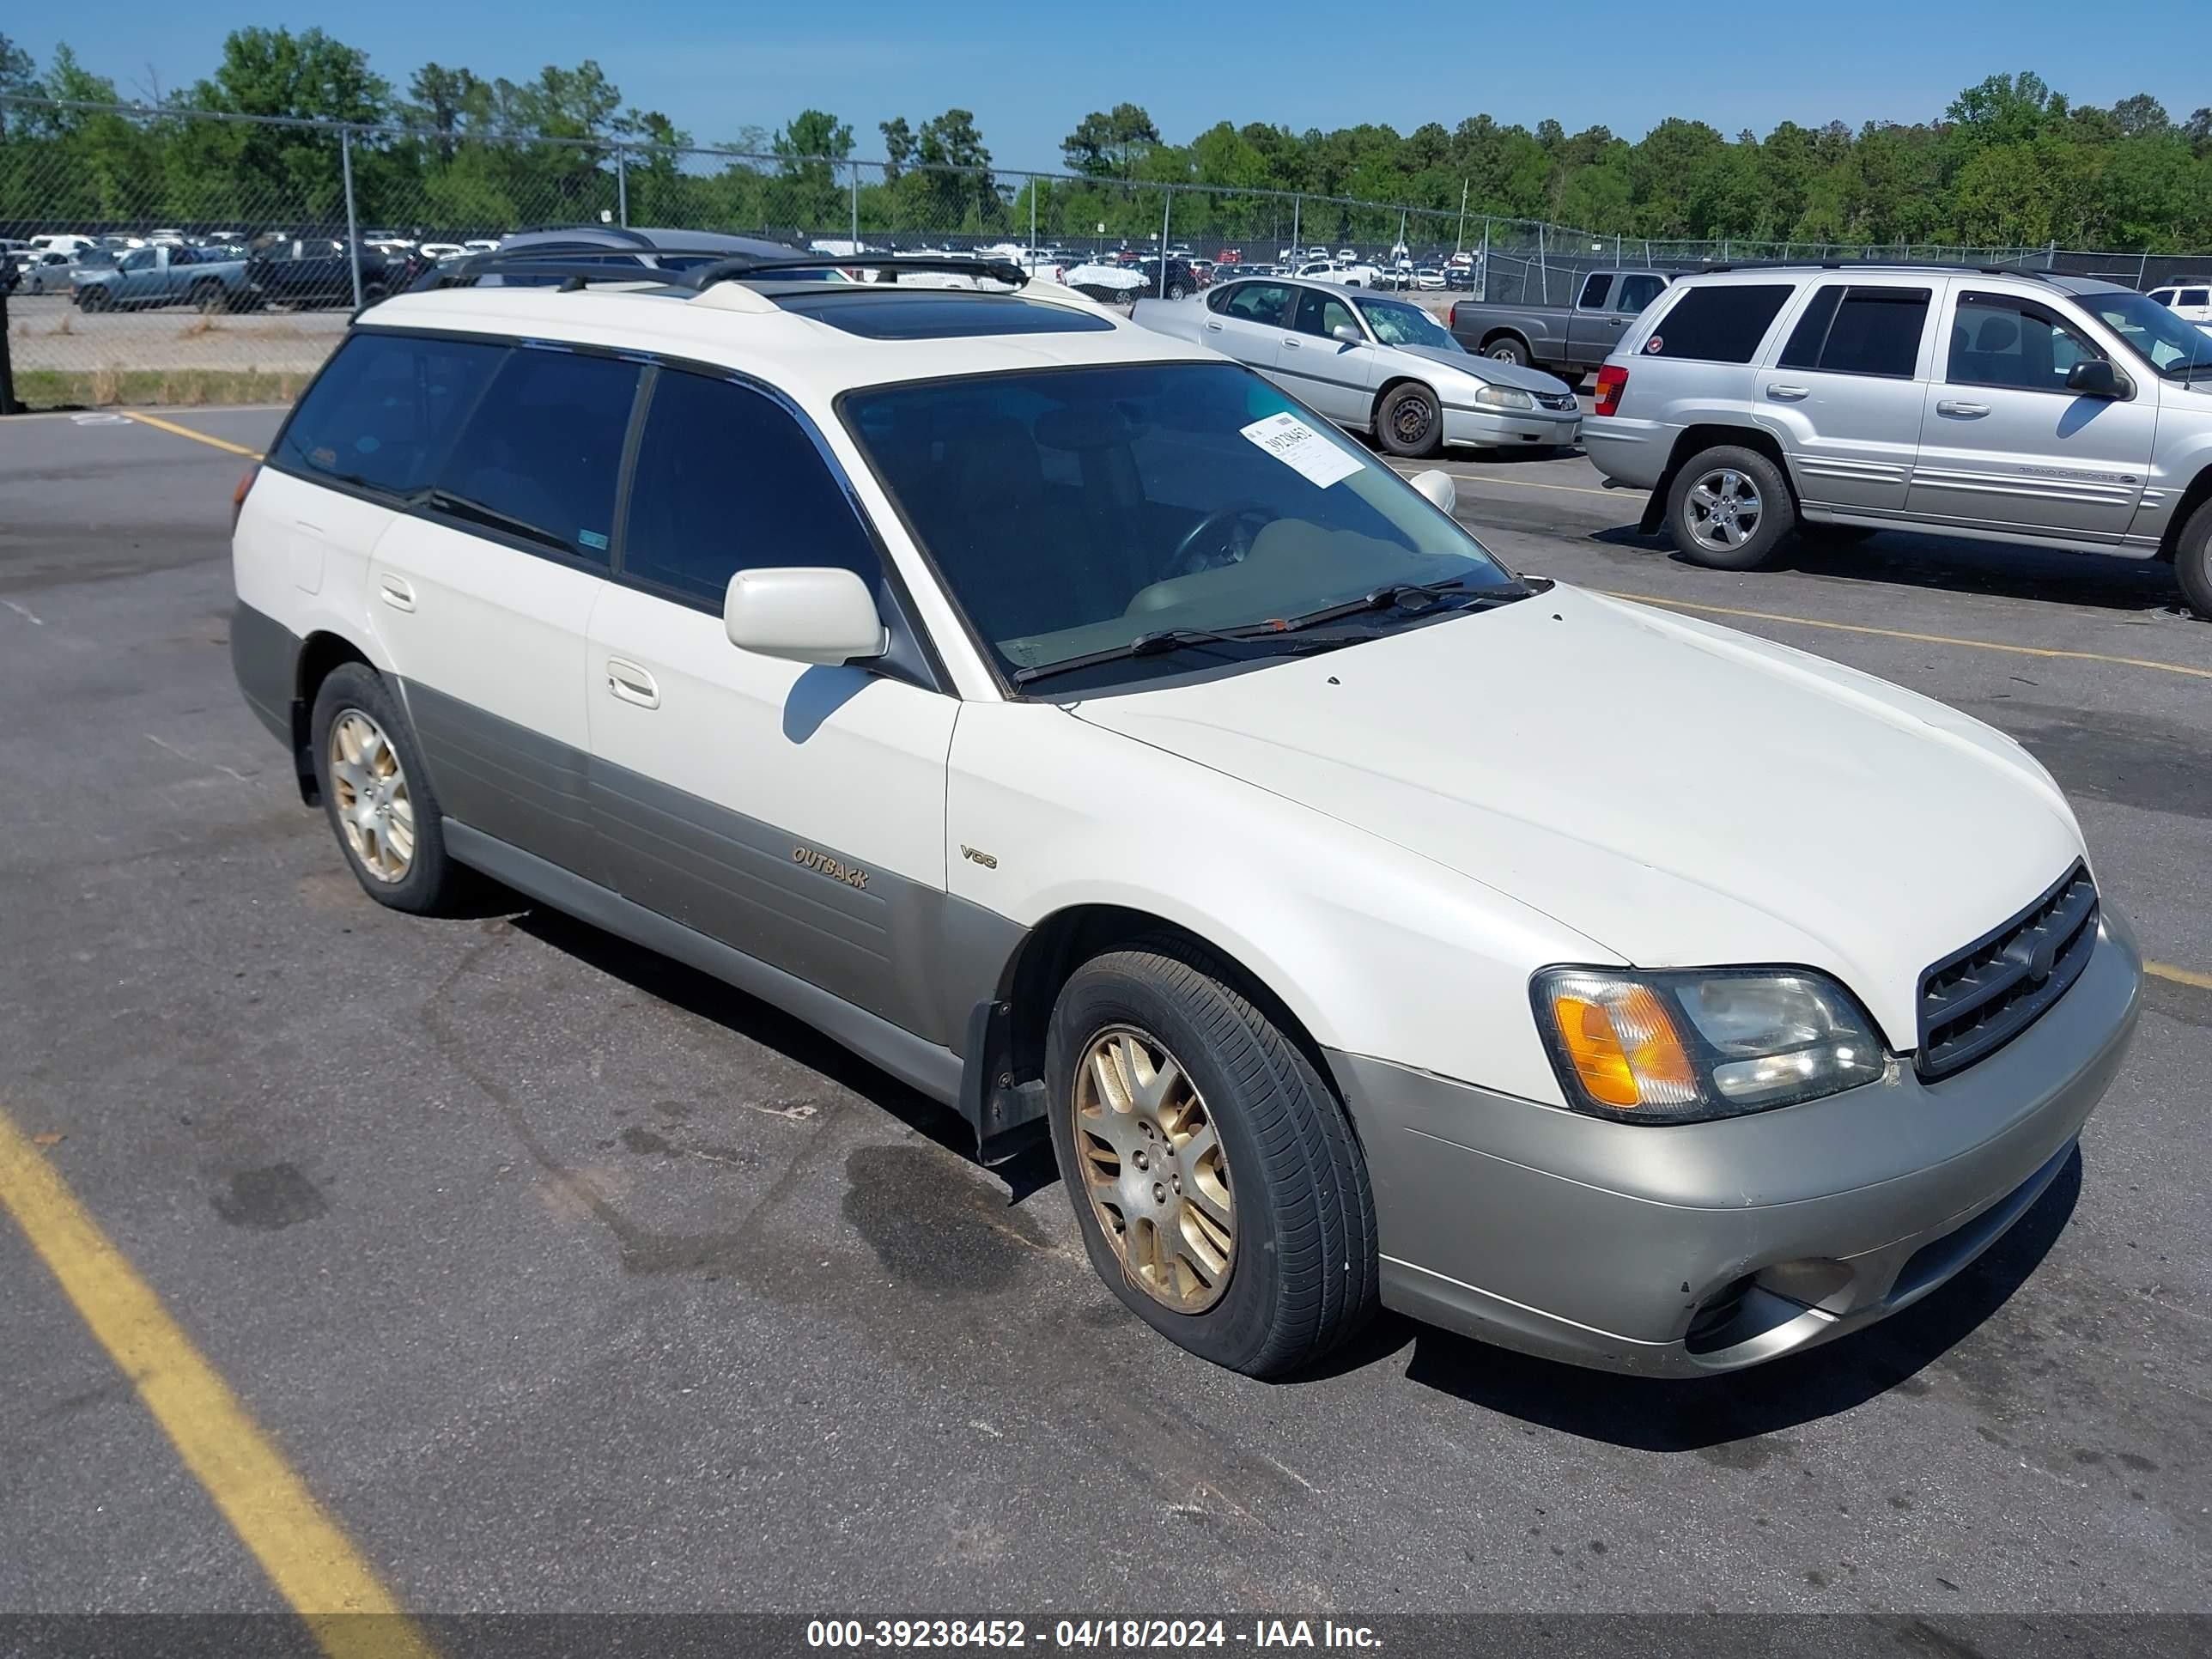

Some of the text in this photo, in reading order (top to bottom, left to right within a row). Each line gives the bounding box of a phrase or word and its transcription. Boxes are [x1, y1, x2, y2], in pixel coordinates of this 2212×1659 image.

[1265, 427, 1313, 453] 39238452
[2019, 466, 2056, 475] GRAND
[2058, 471, 2117, 481] CHEROKEE
[792, 846, 870, 890] OUTBACK
[960, 844, 998, 869] VDC
